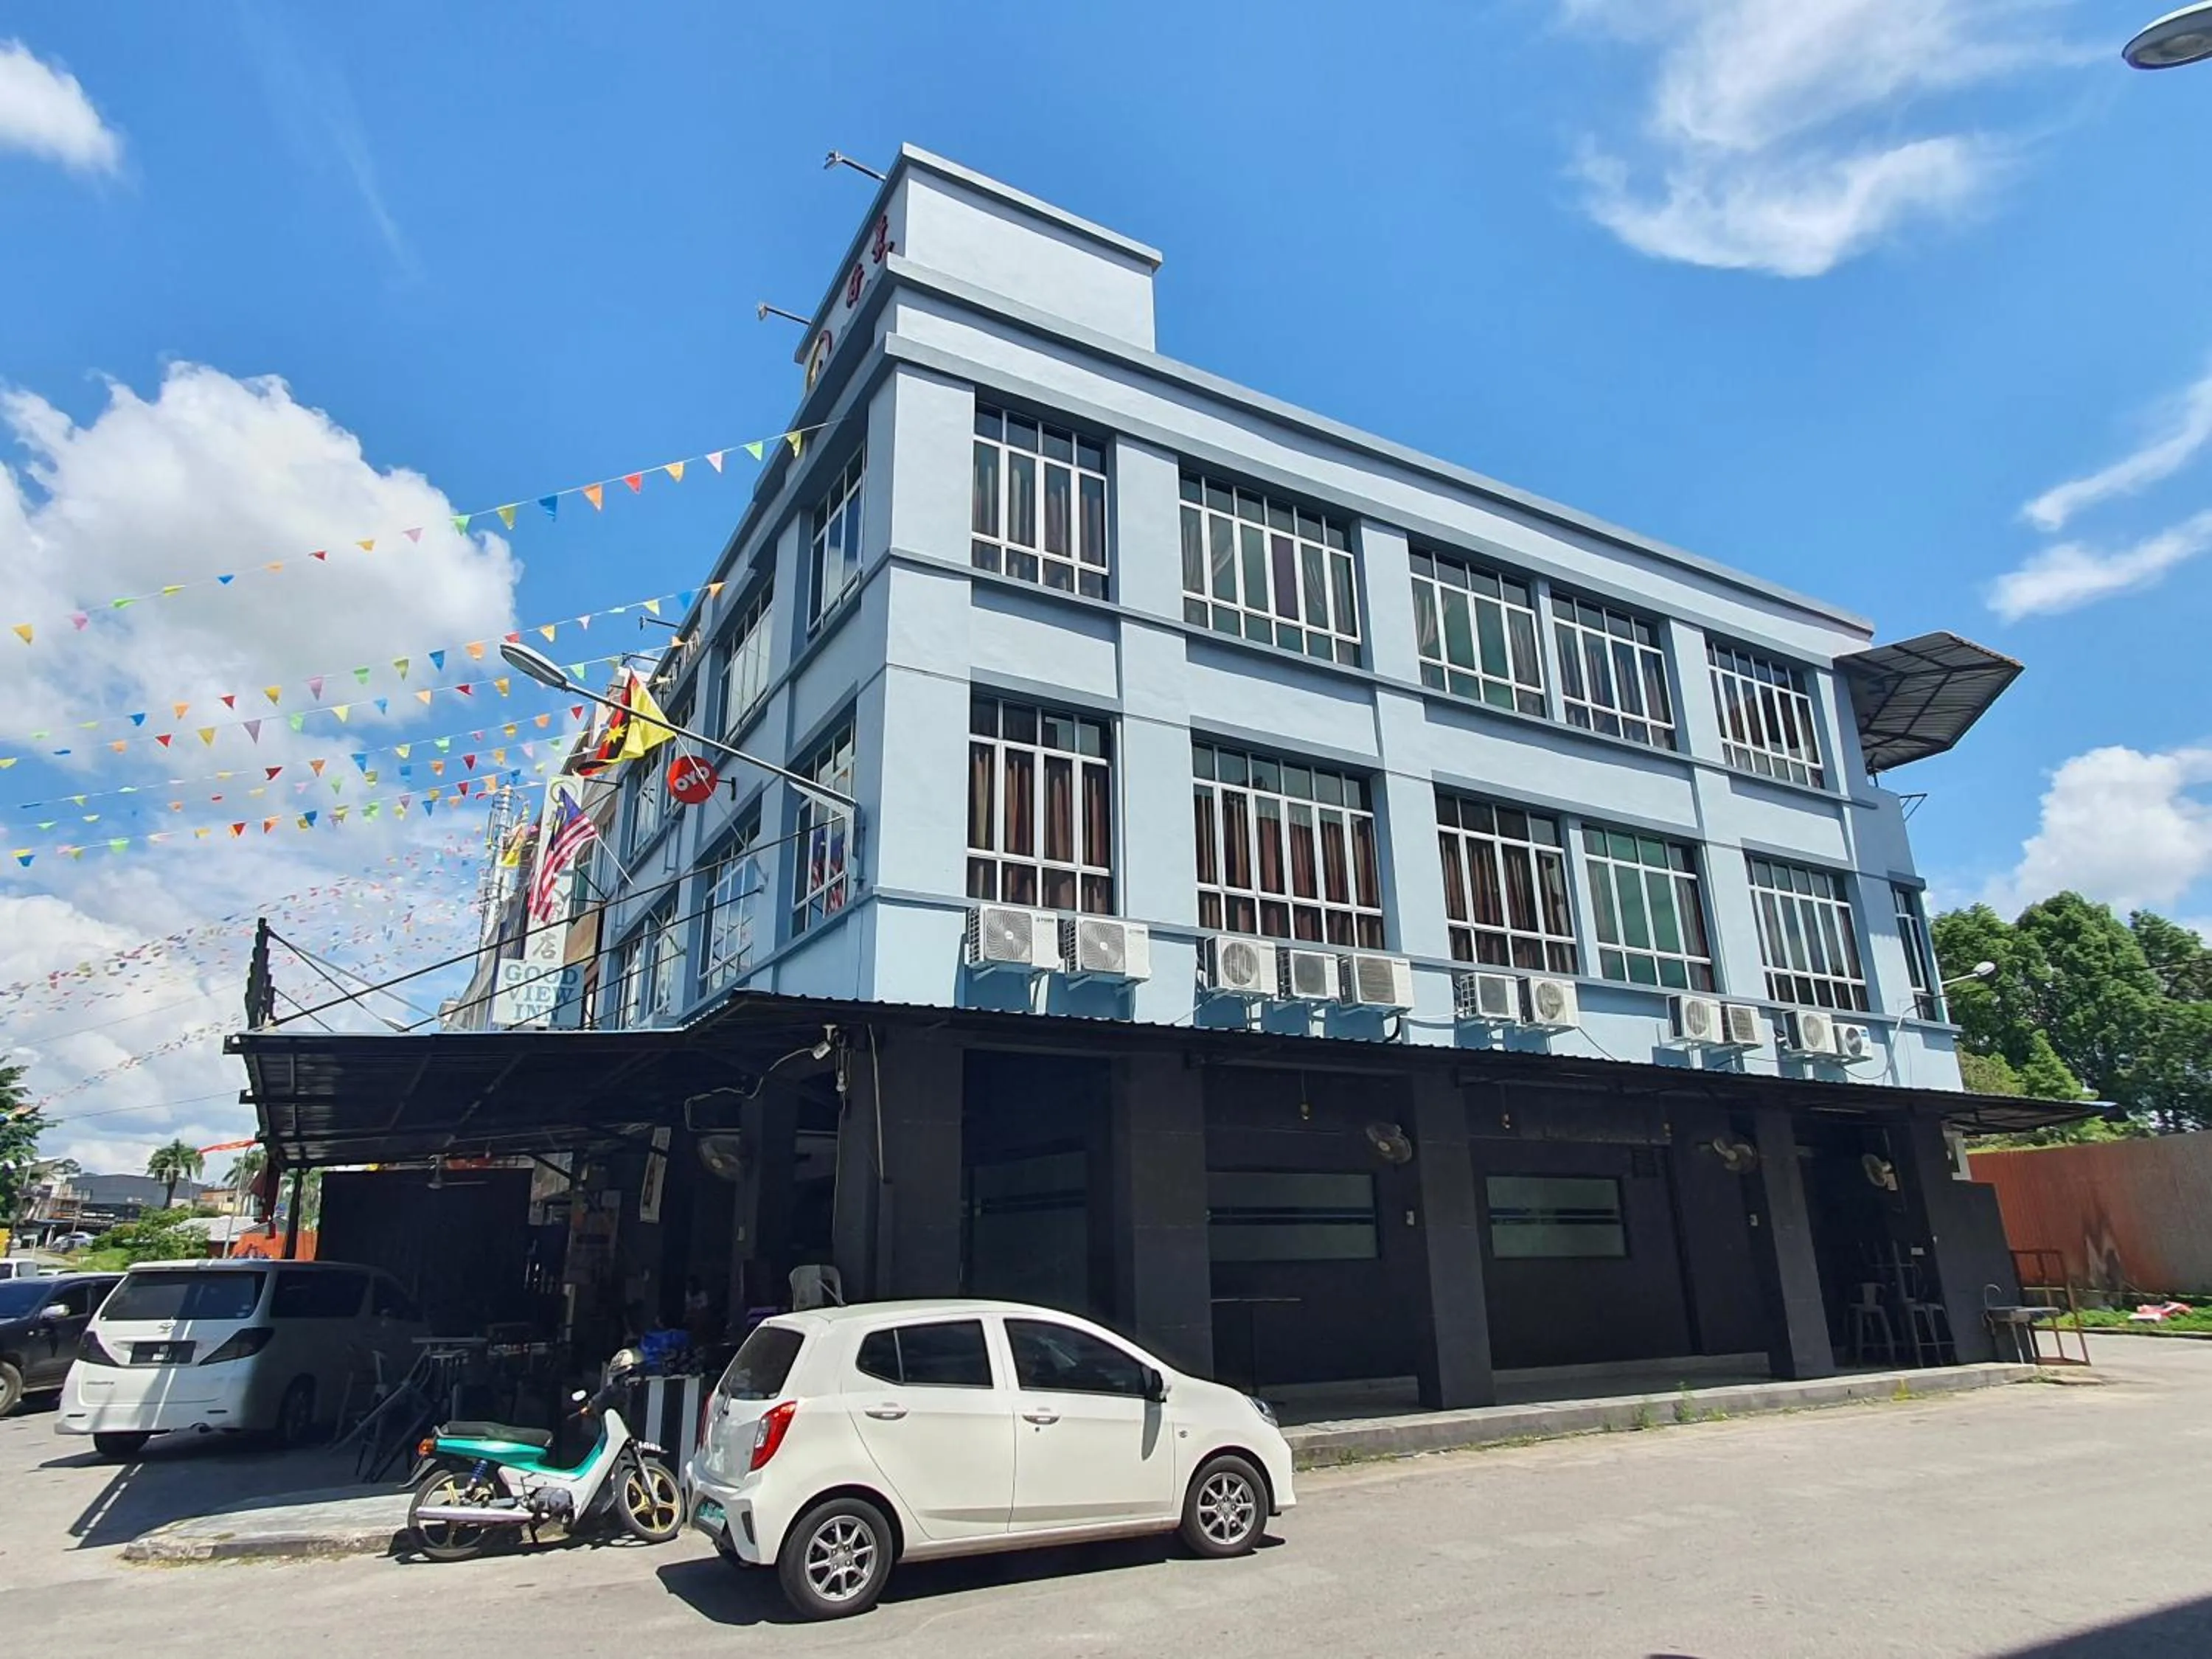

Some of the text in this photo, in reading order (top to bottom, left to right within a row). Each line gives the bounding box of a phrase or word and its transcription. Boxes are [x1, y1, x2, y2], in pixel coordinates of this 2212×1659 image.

[674, 766, 710, 791] OYO
[504, 964, 579, 985] GOOD
[506, 983, 575, 1003] VIEW
[514, 1004, 560, 1023] INN
